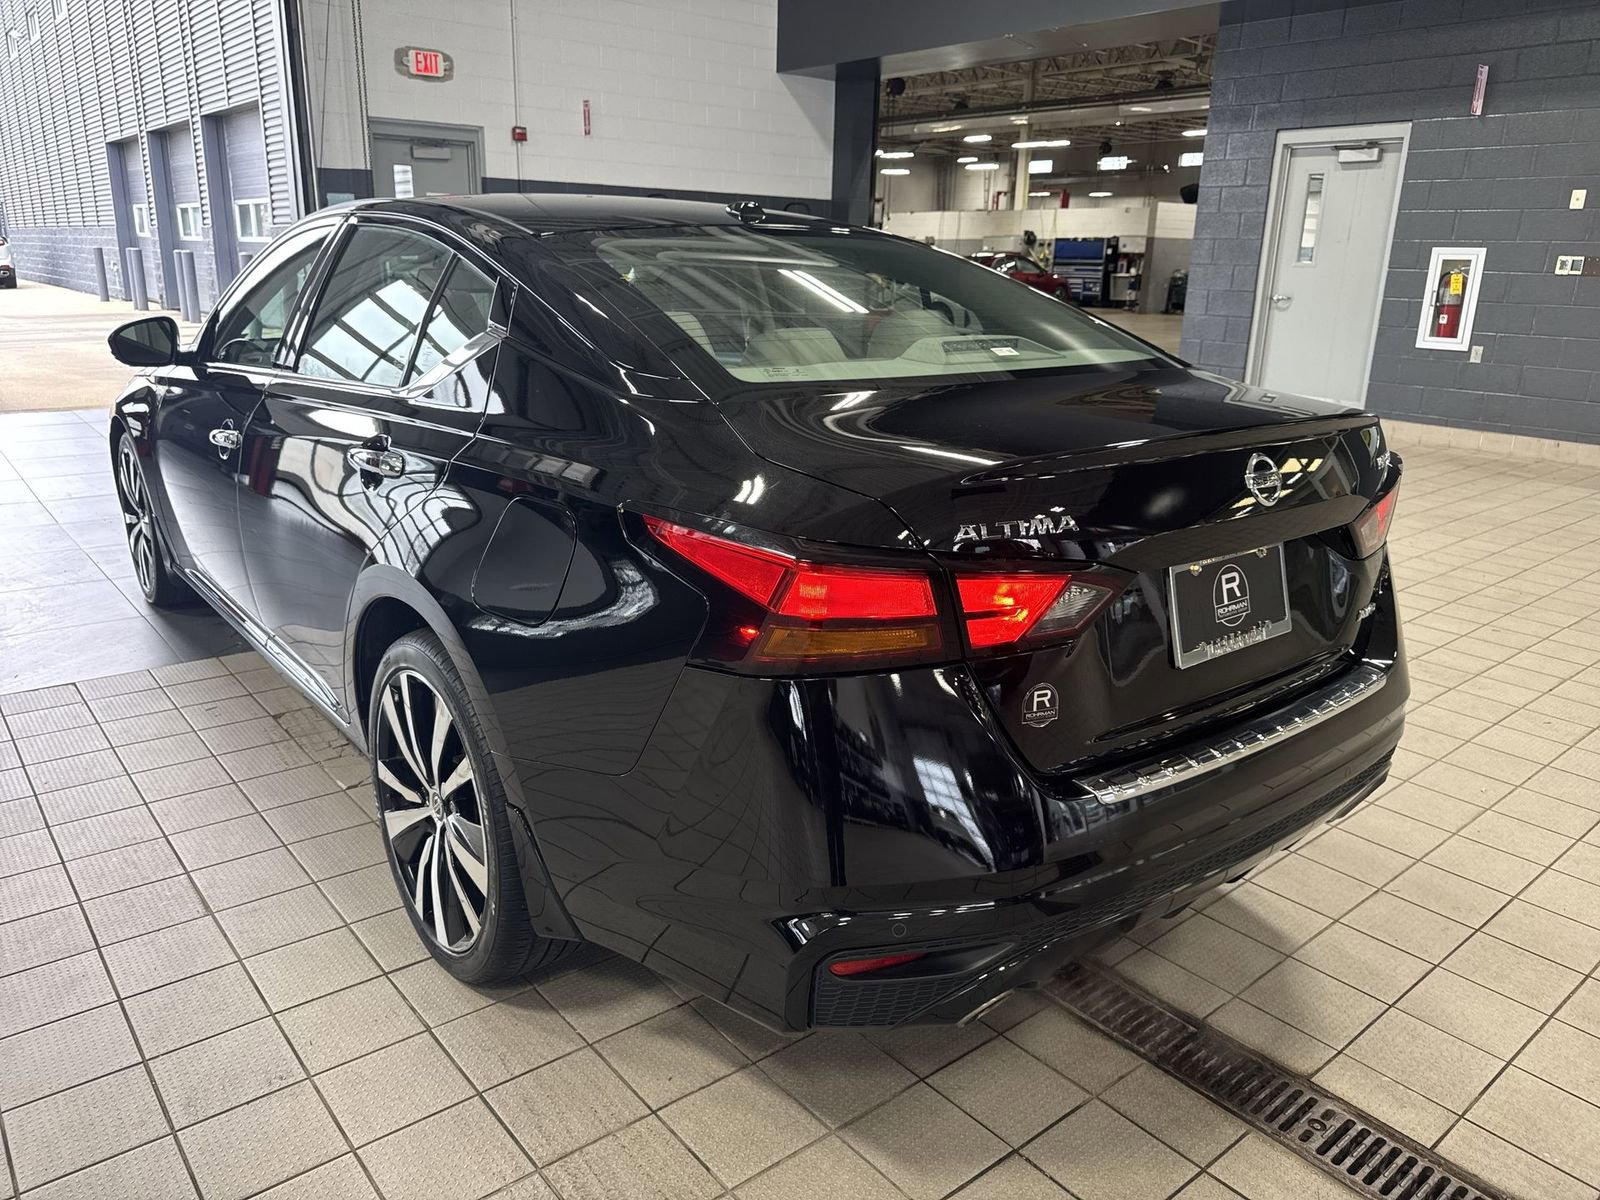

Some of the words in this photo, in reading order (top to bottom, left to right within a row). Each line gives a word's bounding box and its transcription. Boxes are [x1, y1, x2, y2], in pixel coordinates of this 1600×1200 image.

[415, 51, 438, 74] EXIT
[953, 515, 1080, 543] ALTIMA
[1221, 571, 1241, 604] R
[1217, 600, 1248, 616] ROHRMAN
[1033, 689, 1051, 711] R
[1025, 709, 1056, 720] ROHRMAN
